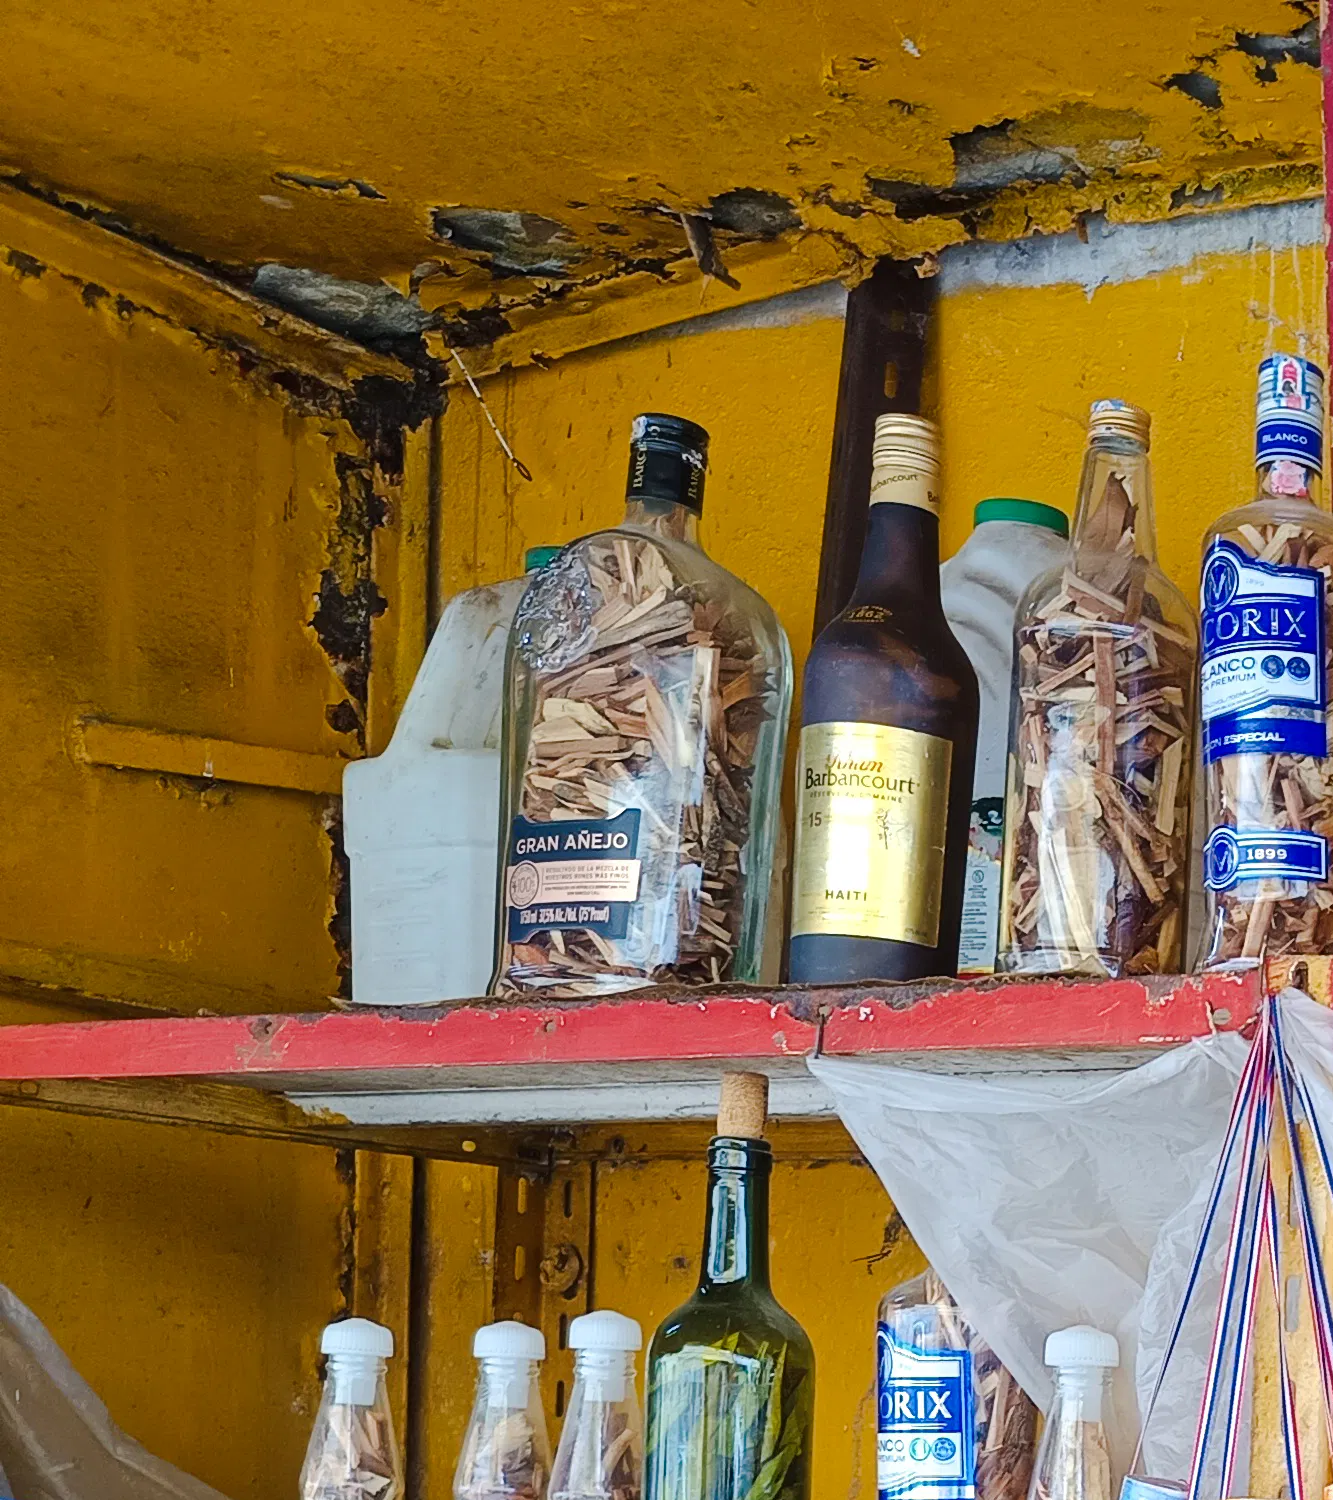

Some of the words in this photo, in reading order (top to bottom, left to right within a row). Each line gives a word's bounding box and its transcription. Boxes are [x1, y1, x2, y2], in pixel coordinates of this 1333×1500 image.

[1262, 432, 1308, 446] BLANCO
[1223, 731, 1286, 746] ESPECIAL
[805, 768, 916, 795] Barbancourt
[808, 811, 823, 828] 15
[516, 834, 560, 855] GRAN
[564, 829, 628, 851] AÑEJO
[1244, 847, 1287, 863] 1899
[825, 889, 868, 902] HAITI
